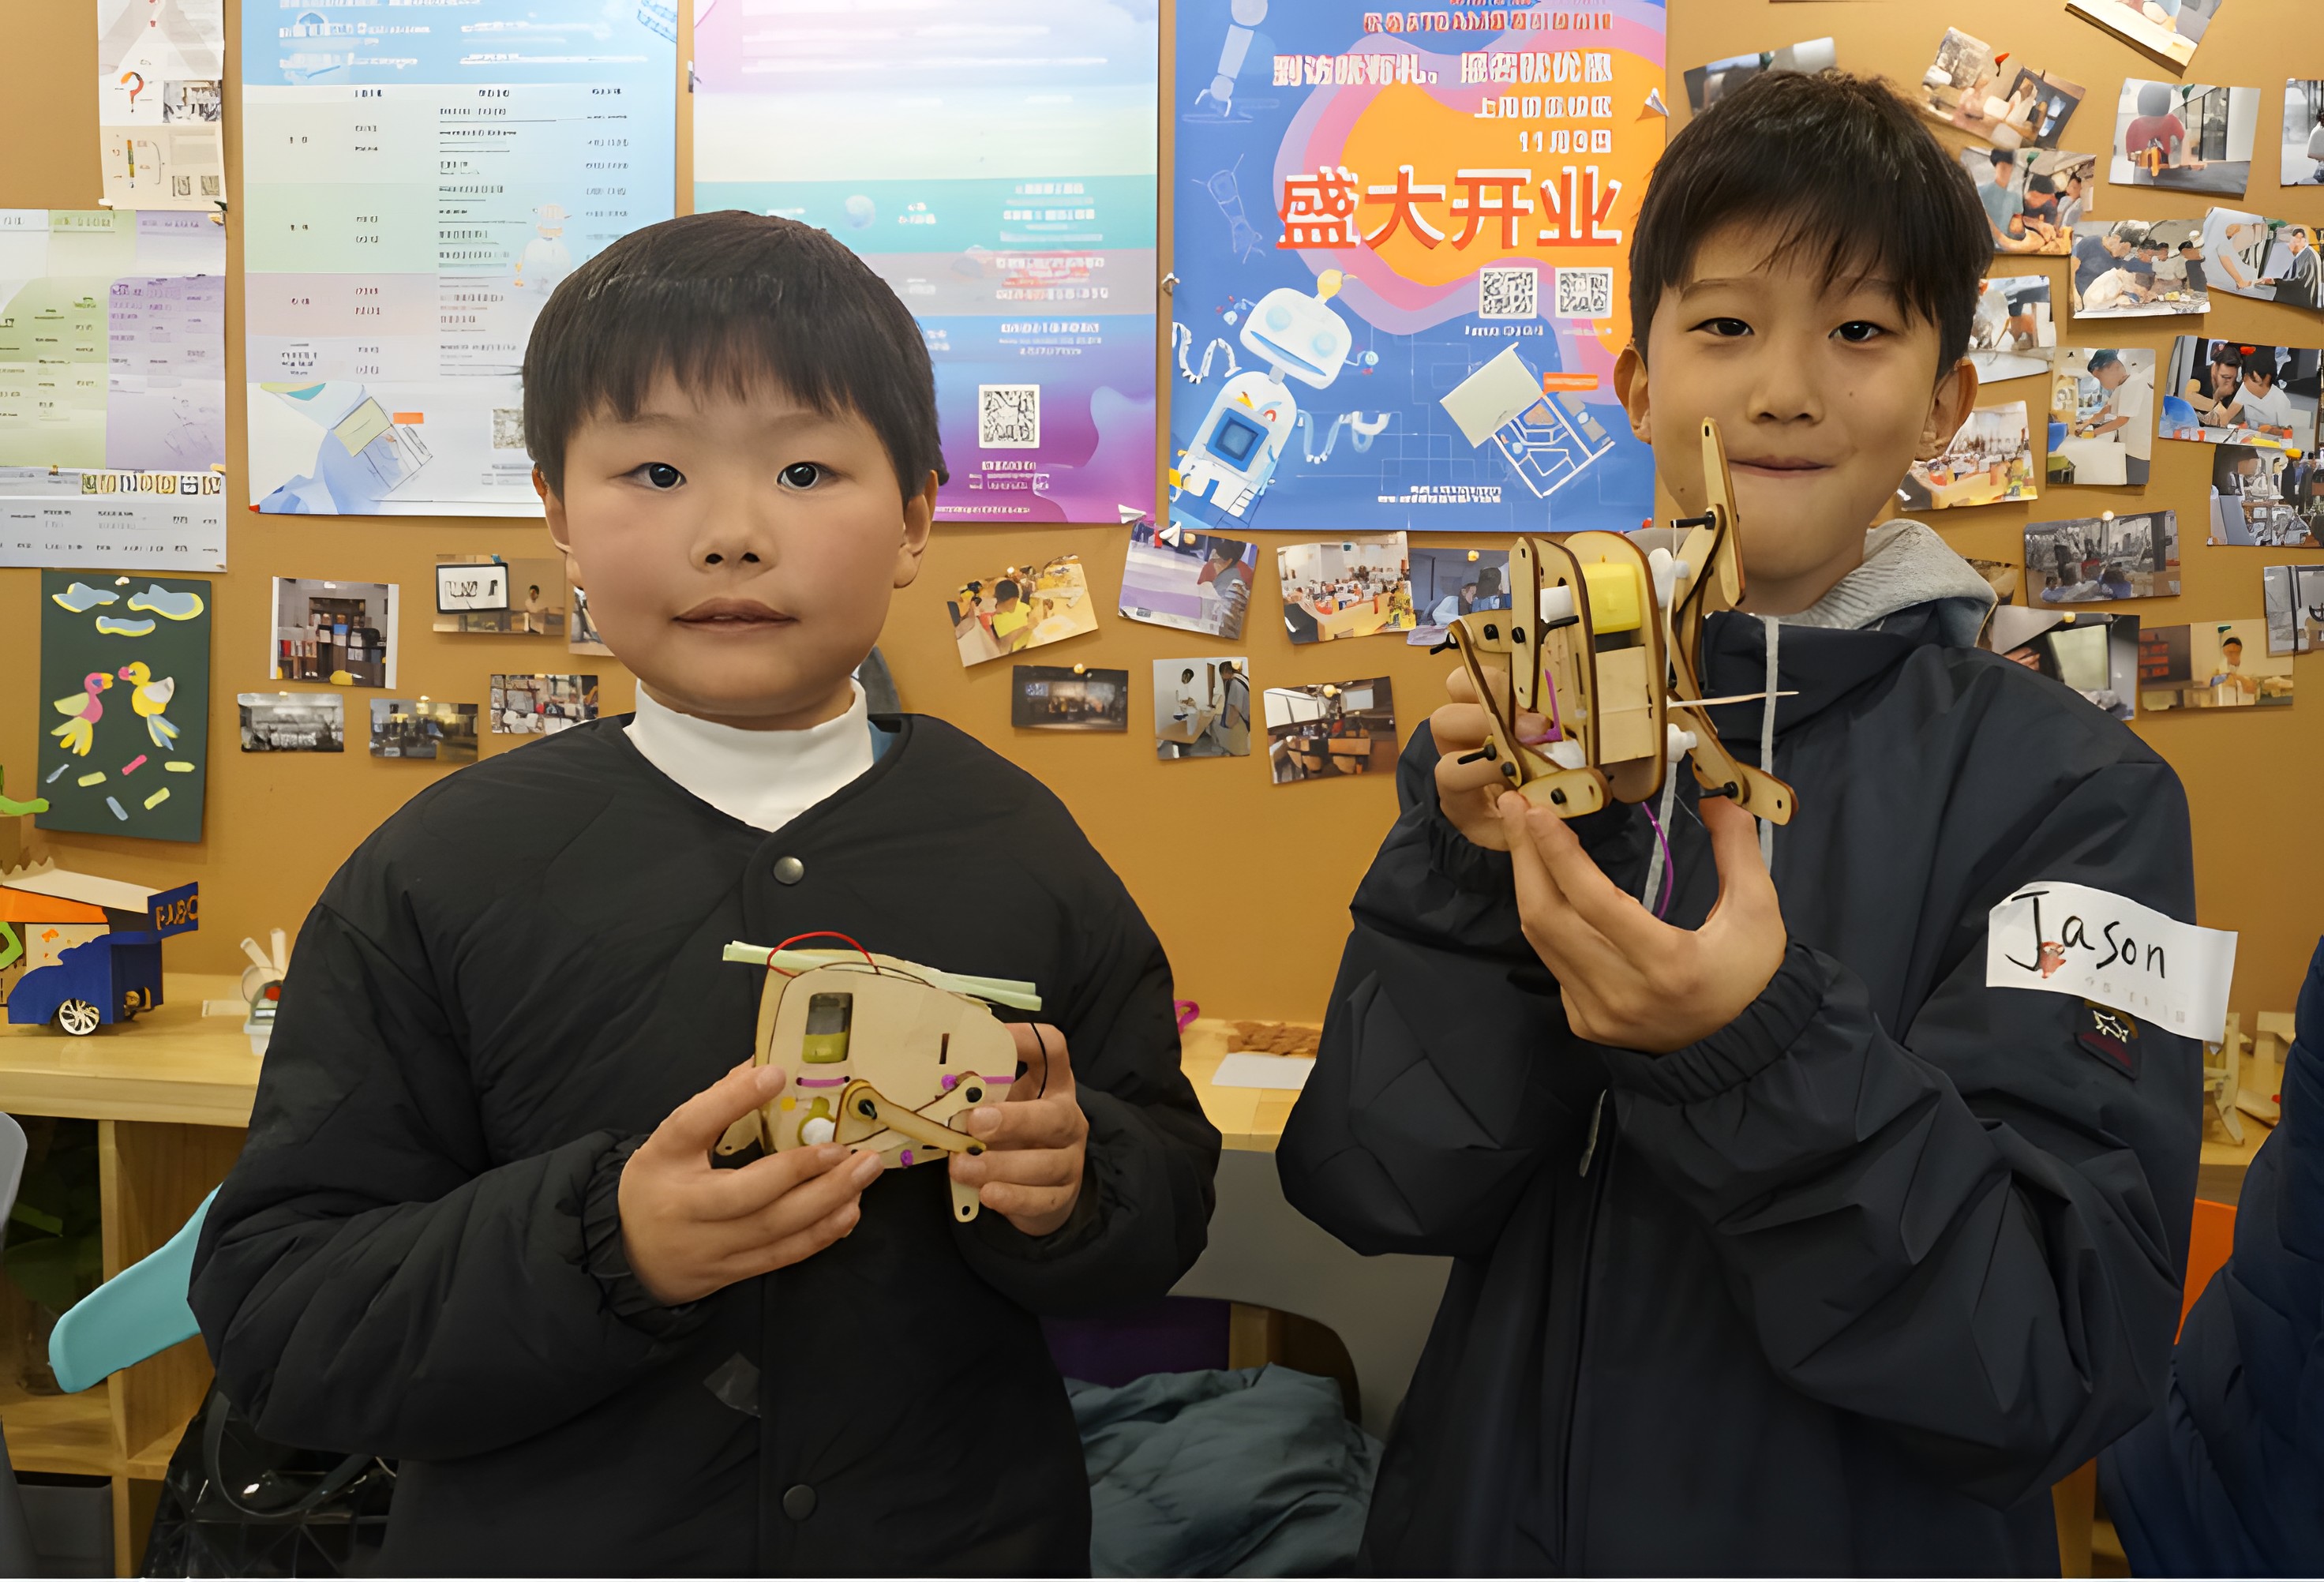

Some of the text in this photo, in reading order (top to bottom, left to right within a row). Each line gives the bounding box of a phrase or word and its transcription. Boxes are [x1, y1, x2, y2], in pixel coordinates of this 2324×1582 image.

[1276, 164, 1623, 250] 盛大开业
[2004, 890, 2166, 979] Jason
